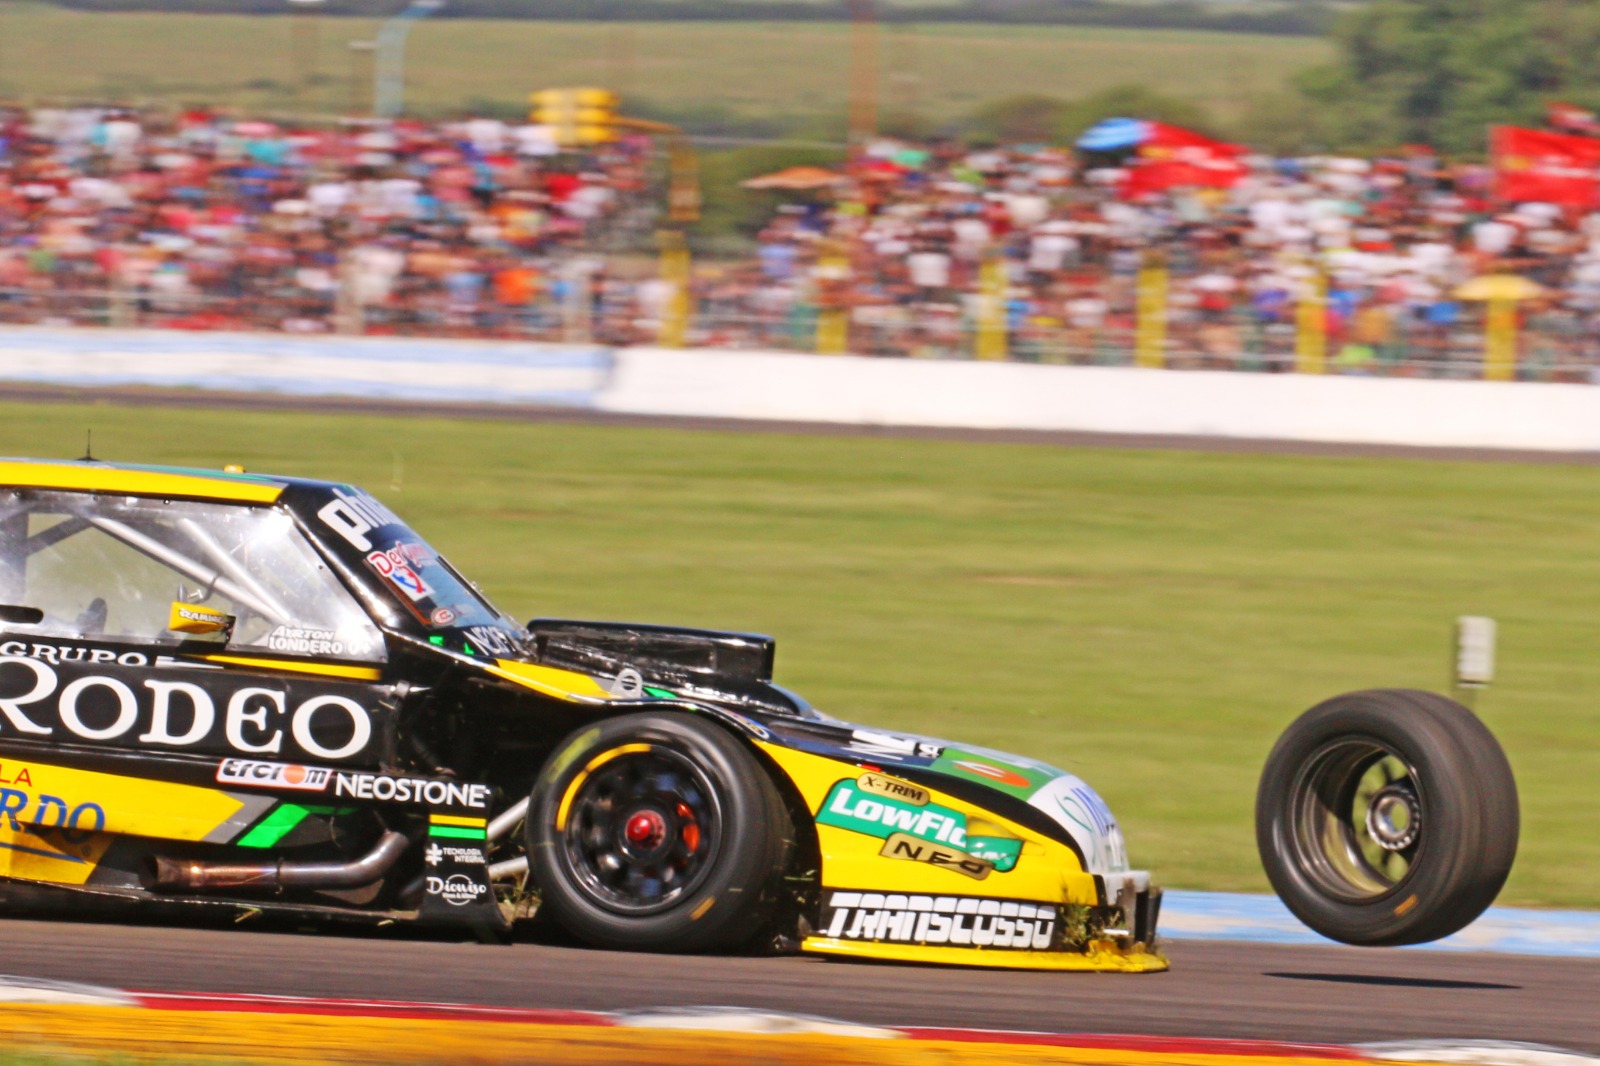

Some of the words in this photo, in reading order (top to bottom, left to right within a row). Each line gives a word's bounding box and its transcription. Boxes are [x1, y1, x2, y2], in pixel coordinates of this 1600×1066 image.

[0, 641, 149, 666] GRUPO
[269, 636, 344, 655] LONDERO
[0, 656, 371, 760] RODEO
[335, 772, 487, 808] NEOSTONE
[862, 776, 924, 801] X-TRIM
[892, 840, 986, 874] NEO
[826, 891, 1057, 950] TRANSCOSSO
